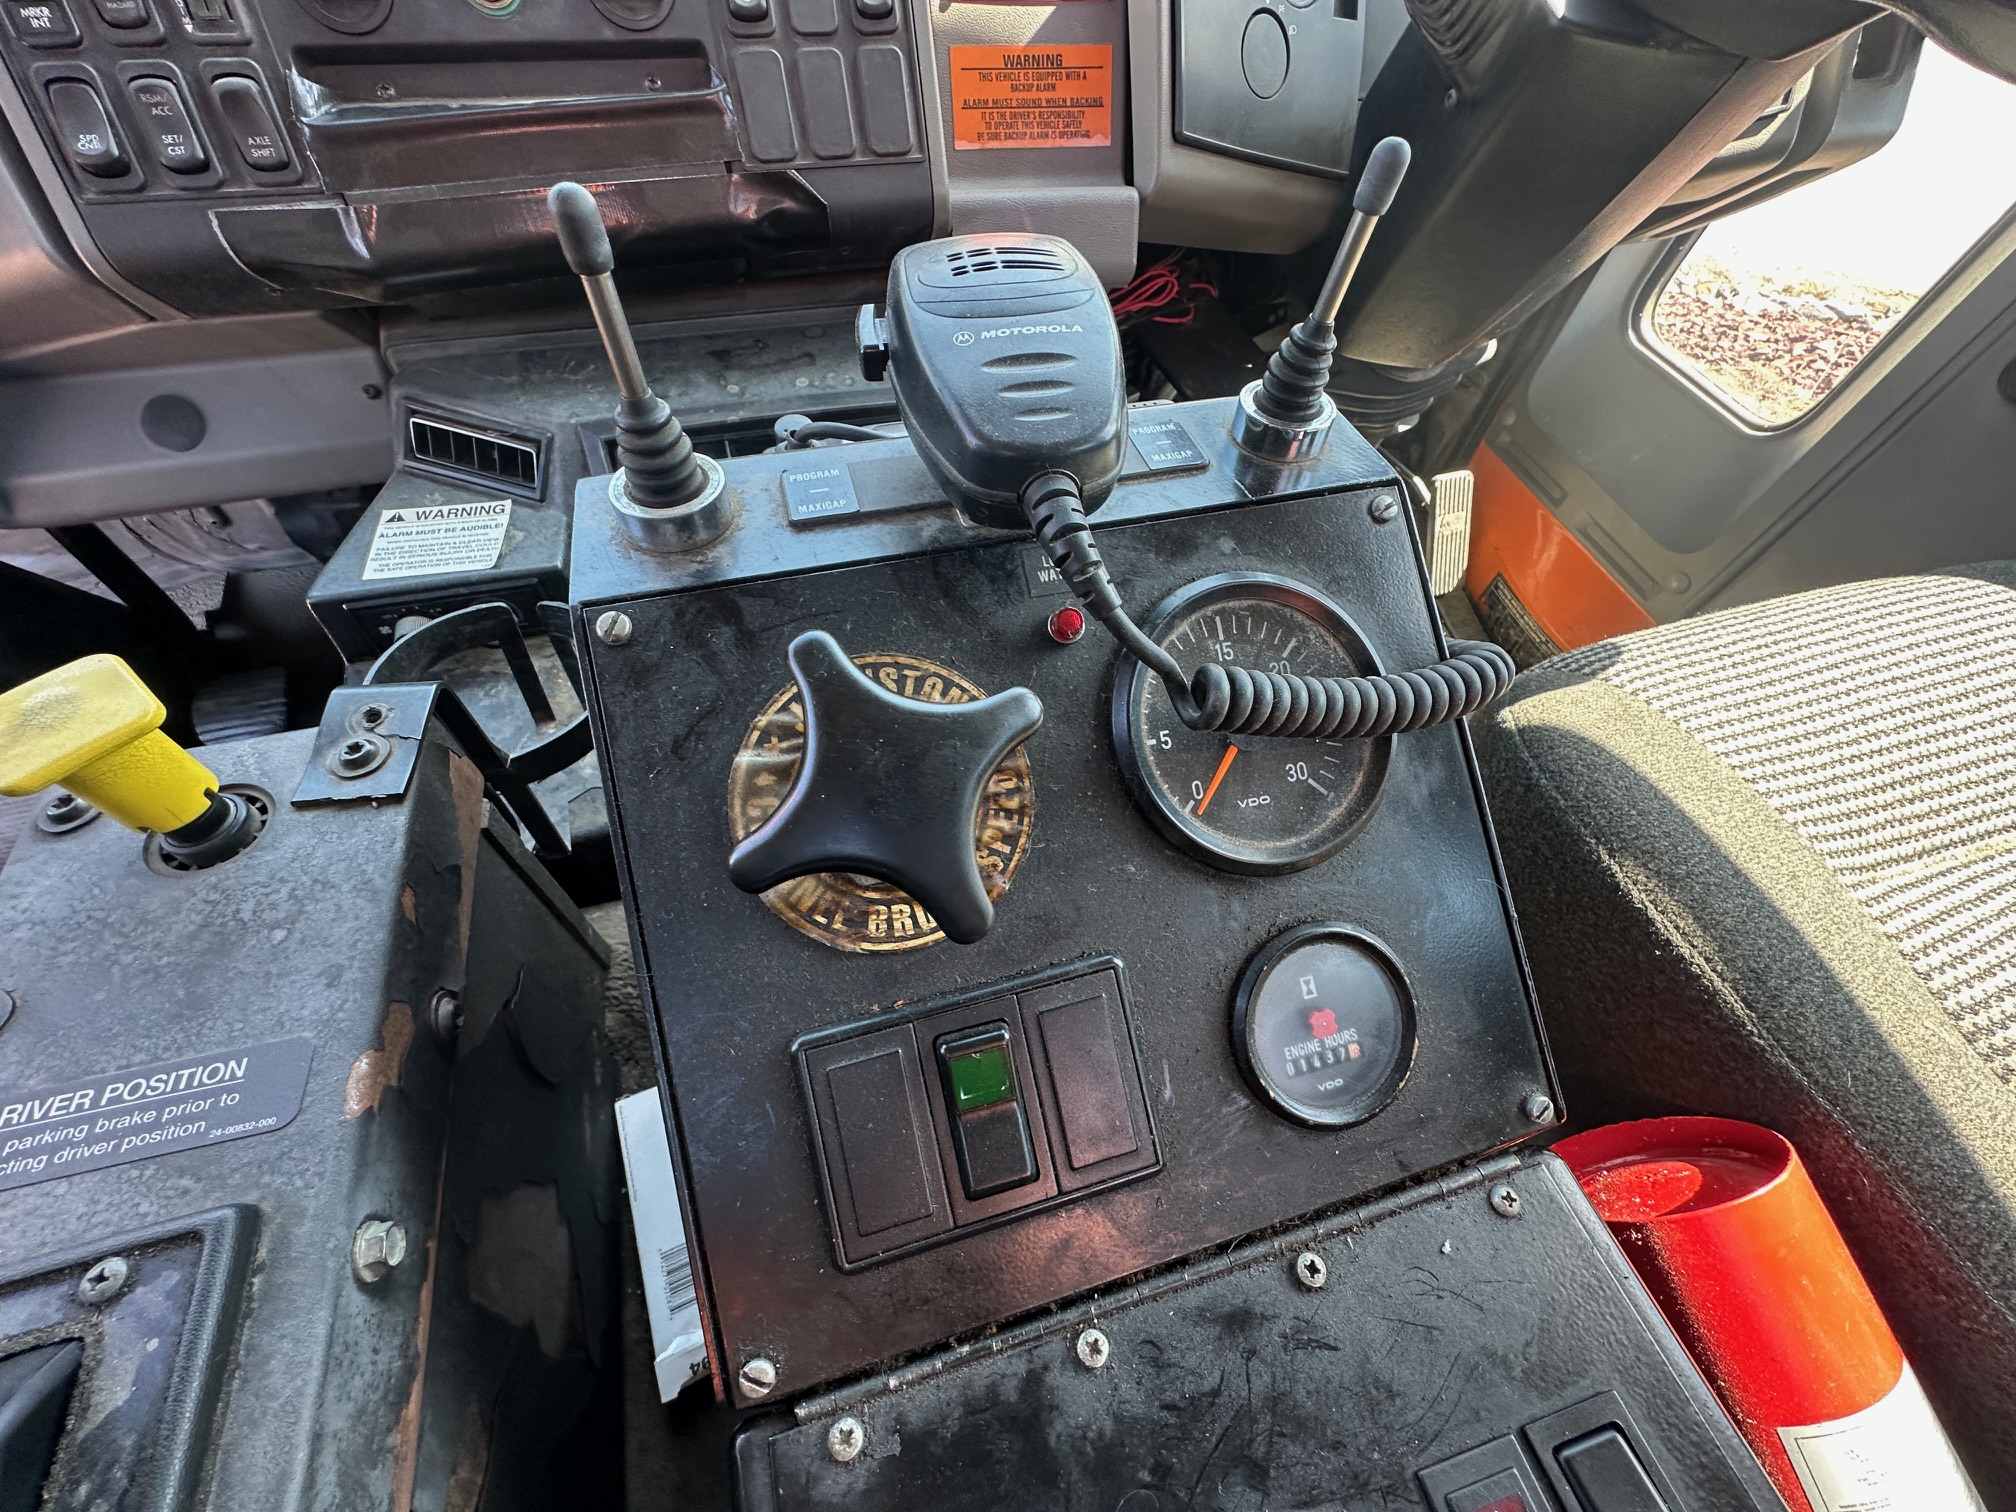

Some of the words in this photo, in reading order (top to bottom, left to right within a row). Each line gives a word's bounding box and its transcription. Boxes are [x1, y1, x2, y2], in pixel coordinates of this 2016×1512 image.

[19, 6, 53, 18] MRKR
[29, 17, 52, 28] INT
[1002, 53, 1063, 68] WARNING
[978, 71, 994, 82] THIS
[994, 71, 1022, 82] VEHICLE
[1023, 71, 1031, 82] IS
[1031, 71, 1064, 82] EQUIPPED
[1064, 70, 1081, 81] WITH
[1082, 70, 1087, 81] A
[1010, 82, 1035, 93] BACKUP
[1035, 82, 1057, 92] ALARM
[962, 98, 990, 108] ALARM
[991, 97, 1014, 107] MUST
[1015, 97, 1043, 107] SOUND
[1044, 96, 1068, 107] WHEN
[1069, 95, 1104, 107] BACKING
[151, 105, 174, 116] ACC
[980, 111, 987, 121] IT
[988, 111, 995, 121] IS
[996, 111, 1008, 121] THE
[1008, 110, 1037, 121] DRIVER'S
[1037, 110, 1086, 120] RESPONSIBILITY
[984, 121, 993, 131] TO
[993, 120, 1020, 131] OPERATE
[1020, 120, 1035, 130] THIS
[1035, 120, 1061, 130] VEHICLE
[1061, 119, 1083, 130] SAFELY
[78, 133, 100, 144] SPD
[248, 135, 273, 146] AXLE
[976, 131, 986, 142] BE
[986, 131, 1002, 141] SURE
[1003, 131, 1028, 141] BACKUP
[1028, 130, 1050, 140] ALARM
[1050, 130, 1058, 140] IS
[167, 146, 187, 155] CST
[250, 147, 277, 158] SHIFT
[980, 324, 1084, 340] MOTOROLA
[1131, 422, 1177, 436] PROGRAM
[1150, 449, 1194, 463] MAXIGAP
[789, 468, 840, 483] PROGRAM
[416, 504, 506, 521] WARNING
[797, 499, 847, 514] MAXIGAP
[378, 530, 413, 539] ALARM
[415, 528, 443, 536] MUST
[460, 523, 504, 532] AUDIBLE!
[1037, 567, 1064, 584] WAT
[1214, 642, 1234, 662] 15
[1269, 660, 1291, 676] 20
[1160, 730, 1172, 750] 5
[1285, 761, 1308, 783] 30
[1191, 780, 1204, 800] 0
[1237, 795, 1271, 808] VDO
[1284, 1038, 1322, 1060] ENGINE
[1323, 1027, 1359, 1049] HOURS
[0, 1089, 95, 1127] RIVER
[99, 1057, 249, 1107] POSITION
[1317, 1078, 1344, 1092] VDO
[2, 1124, 90, 1157] parking
[94, 1110, 158, 1134] brake
[161, 1099, 216, 1123] prior
[219, 1092, 241, 1107] to
[208, 1116, 278, 1138] 24-00832-000
[0, 1155, 49, 1177] cting
[53, 1139, 119, 1164] driver
[120, 1120, 207, 1154] position
